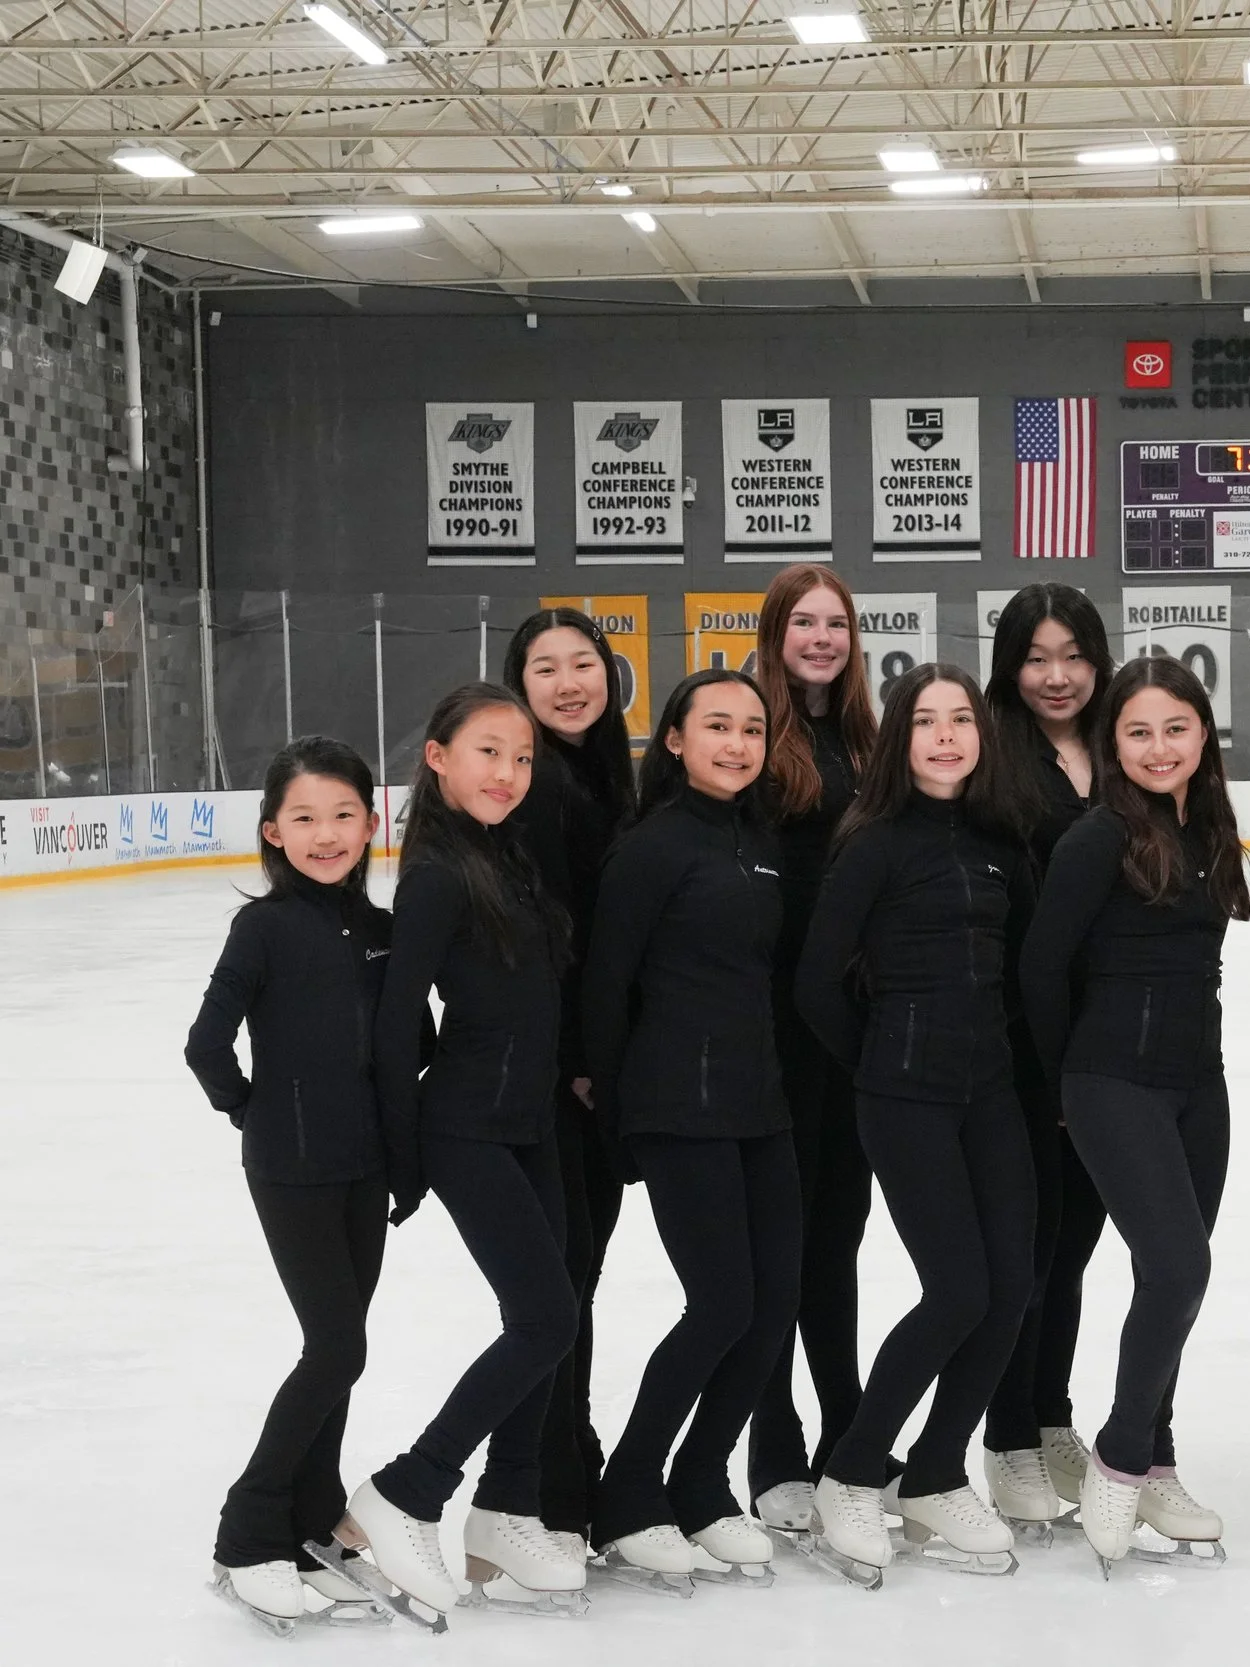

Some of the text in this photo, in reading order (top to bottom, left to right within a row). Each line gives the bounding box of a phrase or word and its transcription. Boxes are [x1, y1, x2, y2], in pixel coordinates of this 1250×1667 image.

[760, 412, 793, 427] LA
[909, 411, 941, 426] LA
[456, 422, 504, 439] KINGS
[604, 422, 651, 439] KINGS
[1139, 445, 1180, 460] HOME
[452, 463, 508, 476] SMYTHE
[591, 462, 665, 475] CAMPBELL
[742, 459, 811, 473] WESTERN
[891, 458, 960, 472] WESTERN
[450, 480, 512, 494] DIVISION
[583, 479, 675, 493] CONFERENCE
[731, 476, 824, 490] CONFERENCE
[880, 475, 972, 489] CONFERENCE
[439, 498, 522, 512] CHAMPIONS
[587, 496, 670, 510] CHAMPIONS
[736, 494, 819, 507] CHAMPIONS
[885, 493, 968, 507] CHAMPIONS
[1126, 509, 1206, 518] PLAYER PENALTY
[446, 519, 517, 537] 1990-91
[592, 517, 666, 535] 1992-93
[745, 515, 811, 532] 2011-12
[892, 514, 961, 531] 2013-14
[700, 612, 760, 631] DIONN
[859, 612, 920, 631] AYLOR
[1128, 605, 1227, 623] ROBITAILLE
[30, 807, 49, 823] VISIT
[33, 823, 108, 855] VANCOUVER
[183, 838, 224, 855] Mammoth
[145, 843, 177, 857] Mammoth
